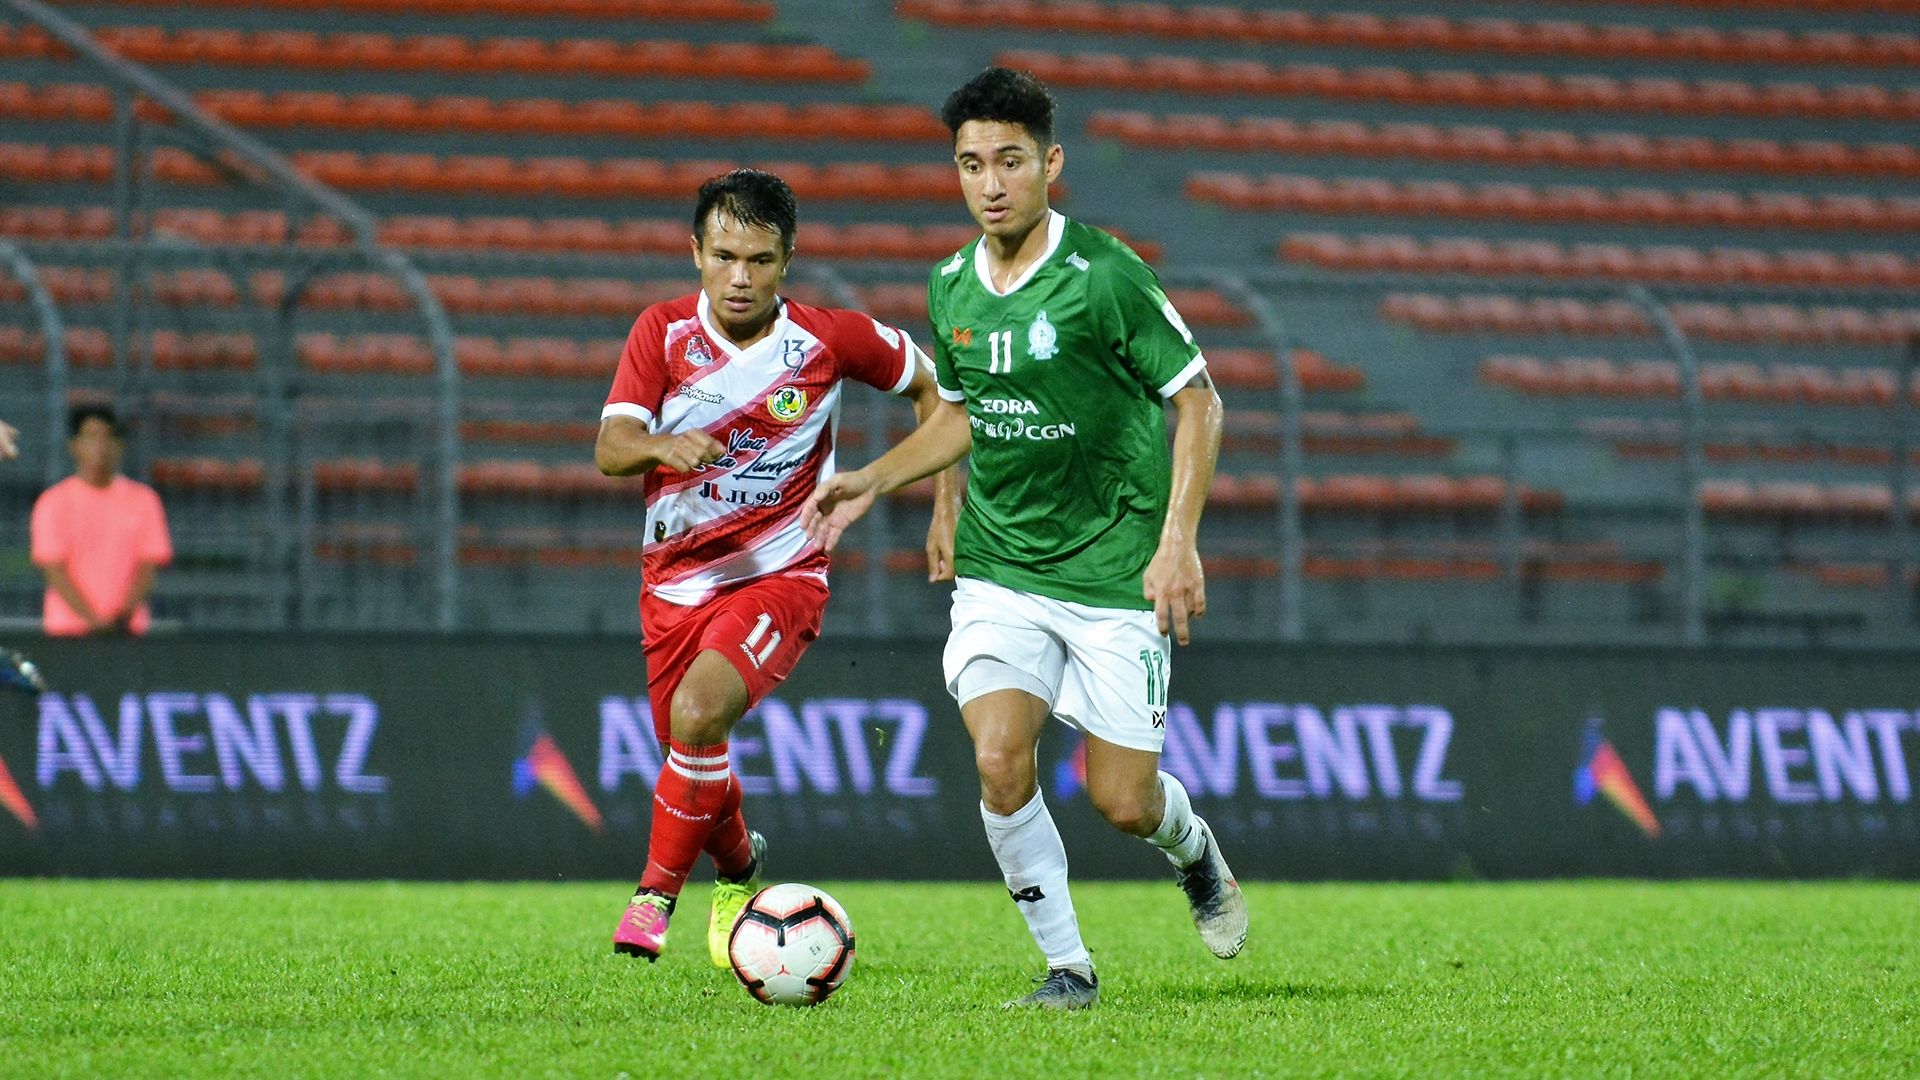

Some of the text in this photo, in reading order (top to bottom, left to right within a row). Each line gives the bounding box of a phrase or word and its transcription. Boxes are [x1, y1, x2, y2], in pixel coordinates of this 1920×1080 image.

[988, 331, 1012, 374] 11
[728, 428, 767, 454] Visit
[1025, 423, 1076, 440] CGN
[745, 612, 782, 665] 11
[1139, 649, 1166, 706] 11
[37, 692, 389, 793] AVENTZ
[599, 696, 939, 796] AENTZ
[1654, 707, 1920, 803] AVENT
